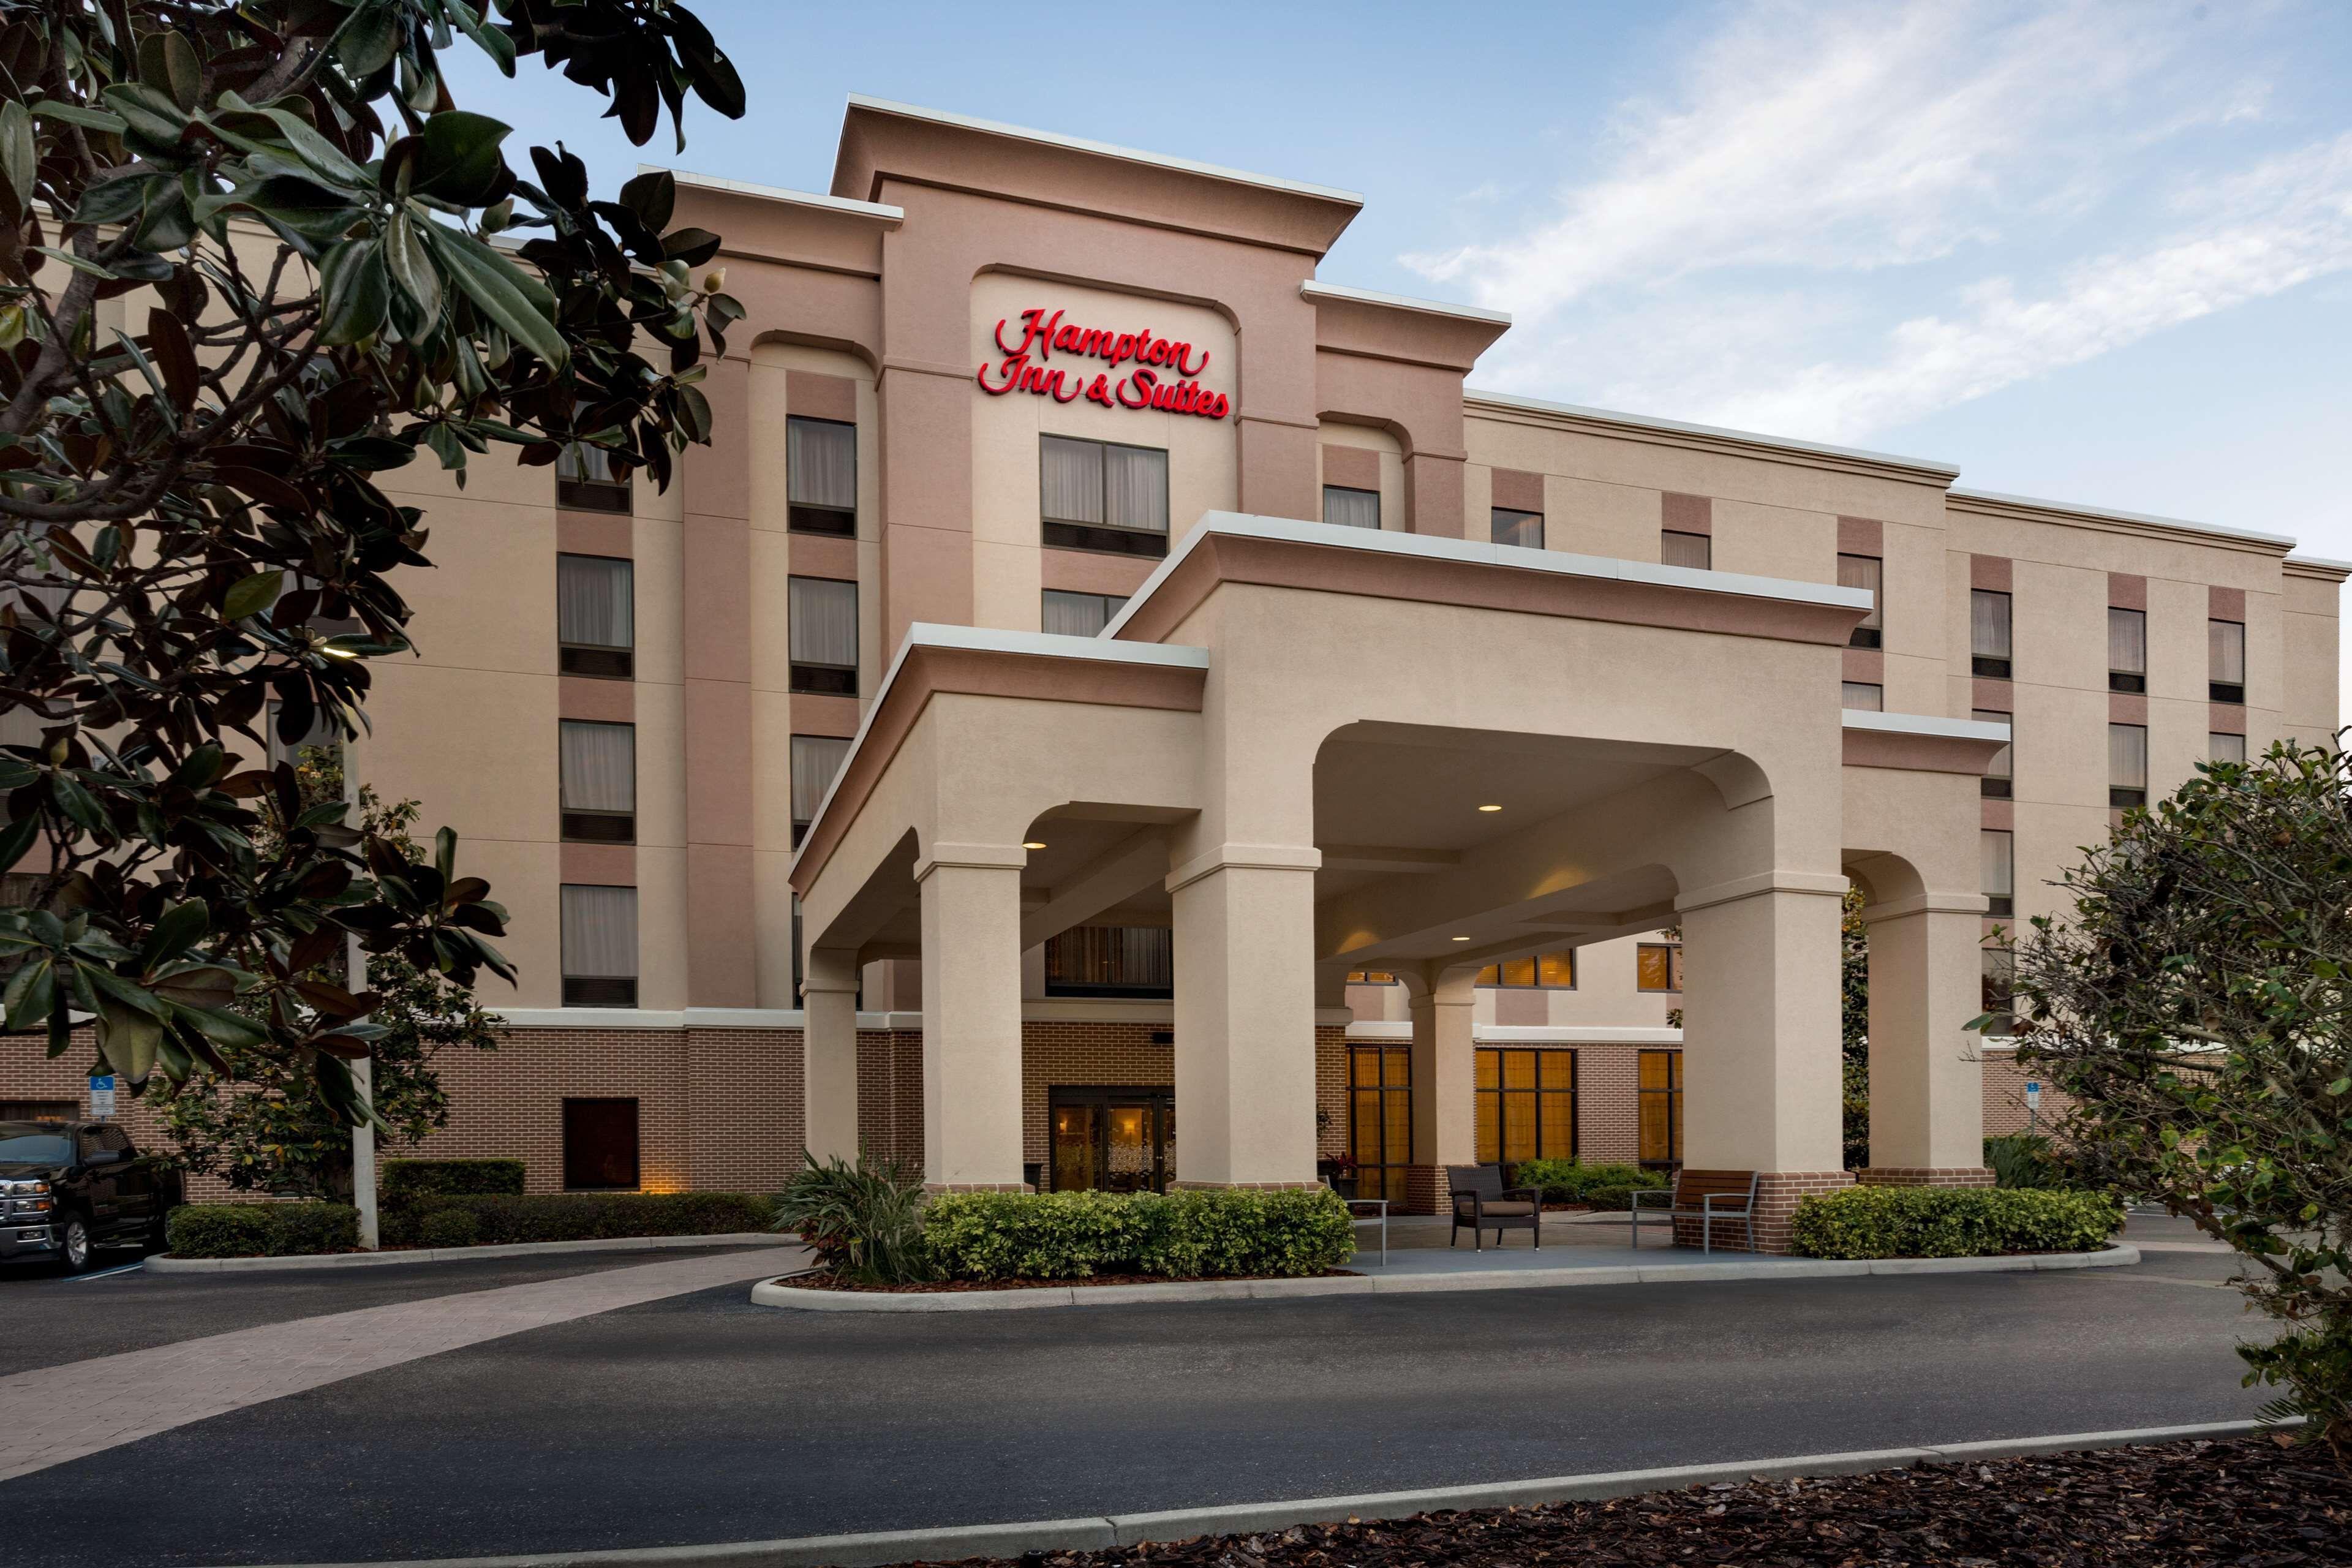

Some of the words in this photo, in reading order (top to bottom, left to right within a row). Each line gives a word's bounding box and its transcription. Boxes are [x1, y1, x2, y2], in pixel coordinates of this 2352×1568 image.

[995, 308, 1210, 376] Hampton
[978, 355, 1083, 403] Inn
[1085, 373, 1115, 409] &
[1116, 368, 1230, 420] Suites
